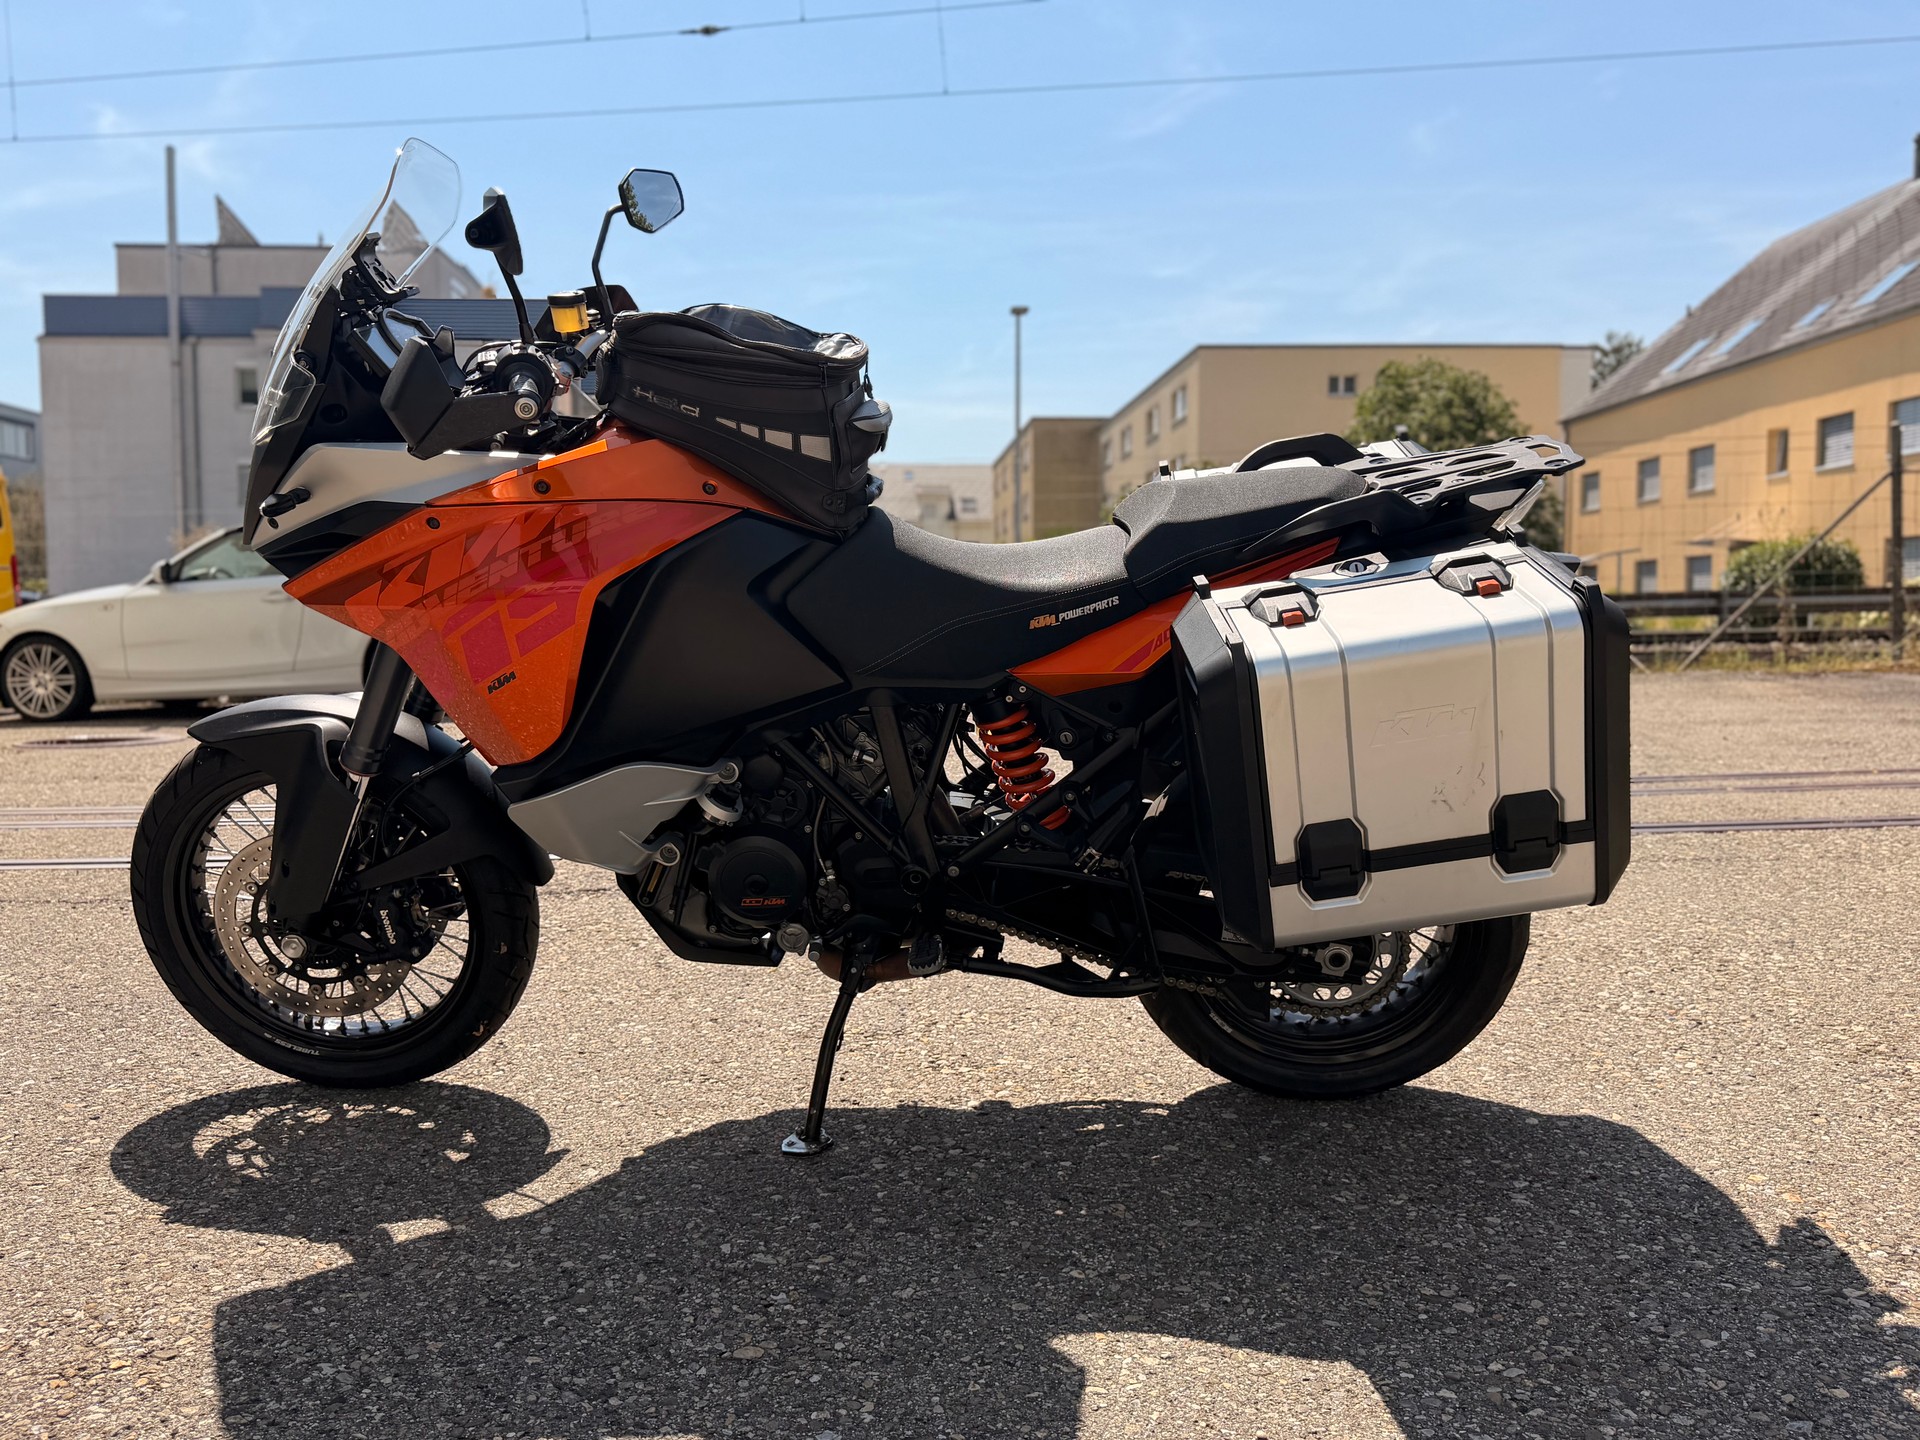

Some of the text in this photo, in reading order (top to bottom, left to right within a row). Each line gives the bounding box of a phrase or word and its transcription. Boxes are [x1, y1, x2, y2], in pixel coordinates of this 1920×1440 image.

[632, 385, 700, 418] Held
[487, 671, 517, 695] KTM
[379, 909, 397, 945] brembo
[274, 1038, 320, 1056] TUBELESS
